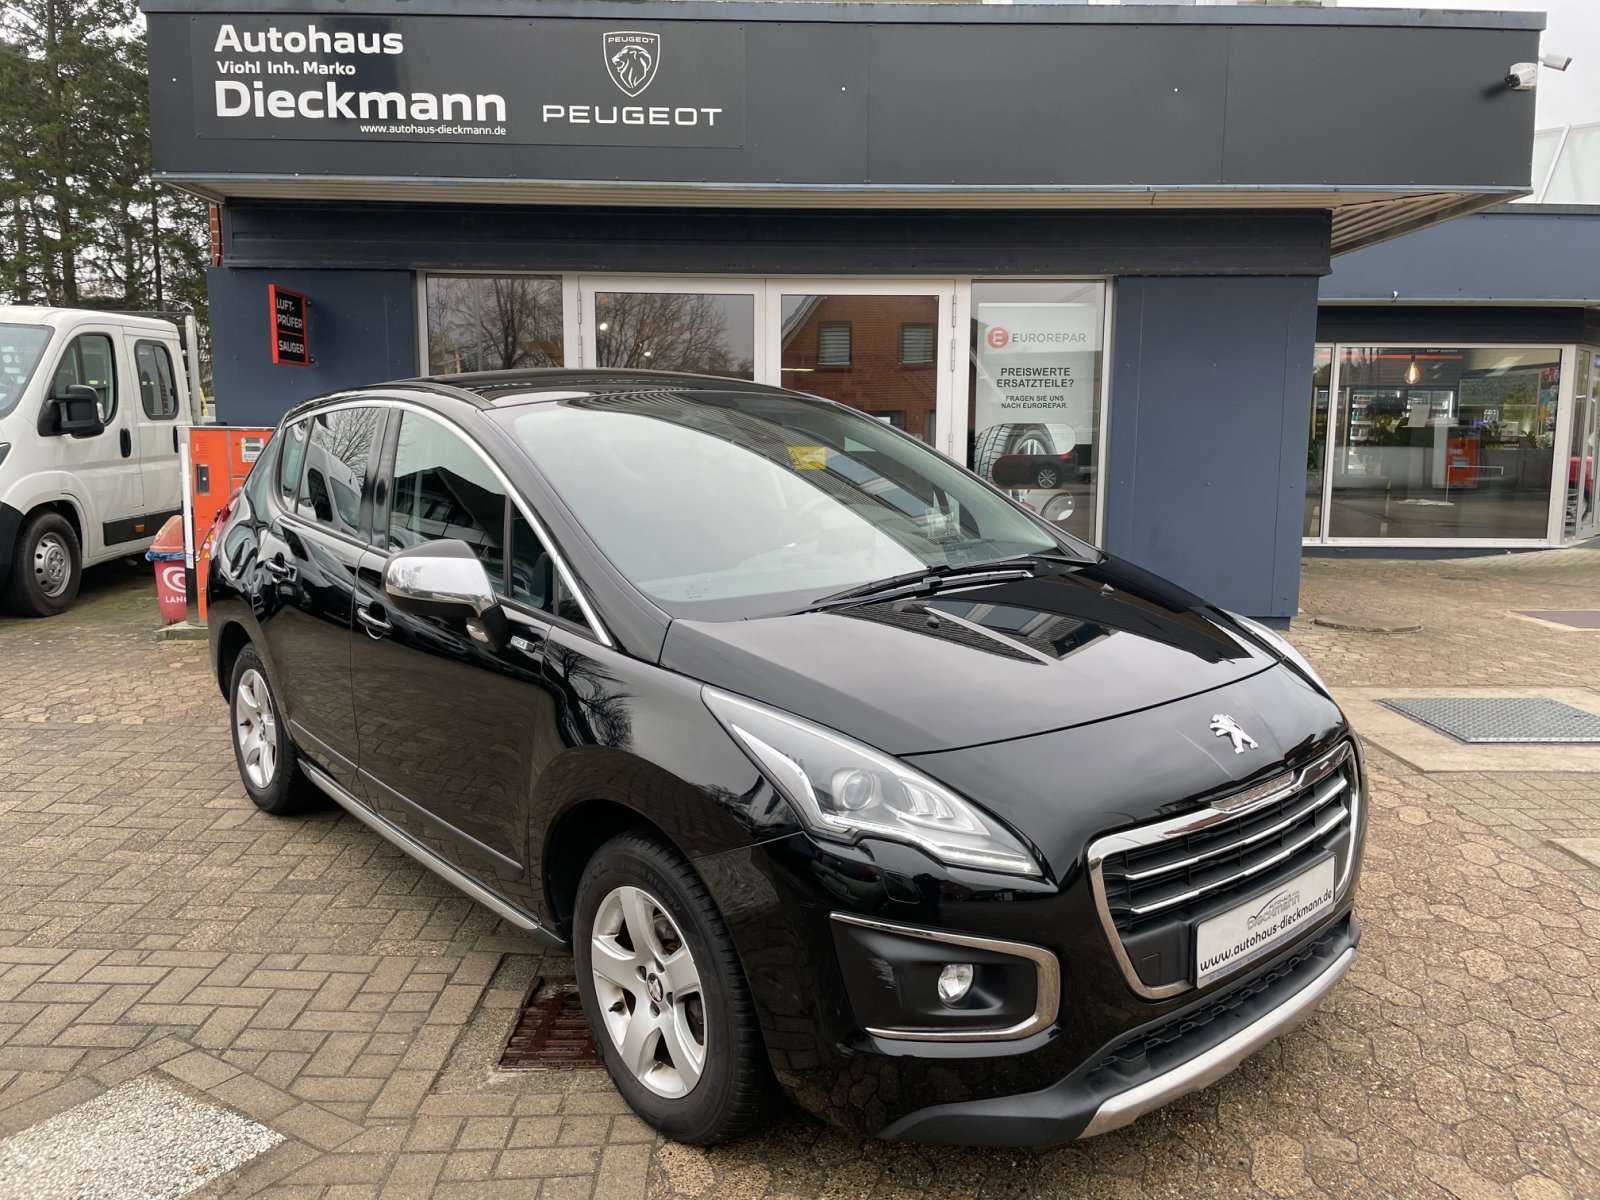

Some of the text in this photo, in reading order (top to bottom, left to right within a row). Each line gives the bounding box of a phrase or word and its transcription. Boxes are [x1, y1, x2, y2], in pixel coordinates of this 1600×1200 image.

[214, 24, 404, 55] Autohaus
[608, 36, 655, 44] PEUGEOT
[216, 60, 357, 76] Viohl Inh. Marko
[214, 80, 507, 122] Dieckmann
[542, 104, 723, 127] PEUGEOT
[360, 122, 507, 136] www.autohaus-dieckmann.de
[277, 313, 303, 329] PRÜFER
[1011, 332, 1087, 343] EUROREPAR
[278, 339, 304, 354] SAUGER
[1000, 367, 1071, 377] PREISWERTE
[996, 378, 1075, 388] ERSATZTEILE?
[1199, 888, 1333, 972] www.autohaus-dieckmann.de
